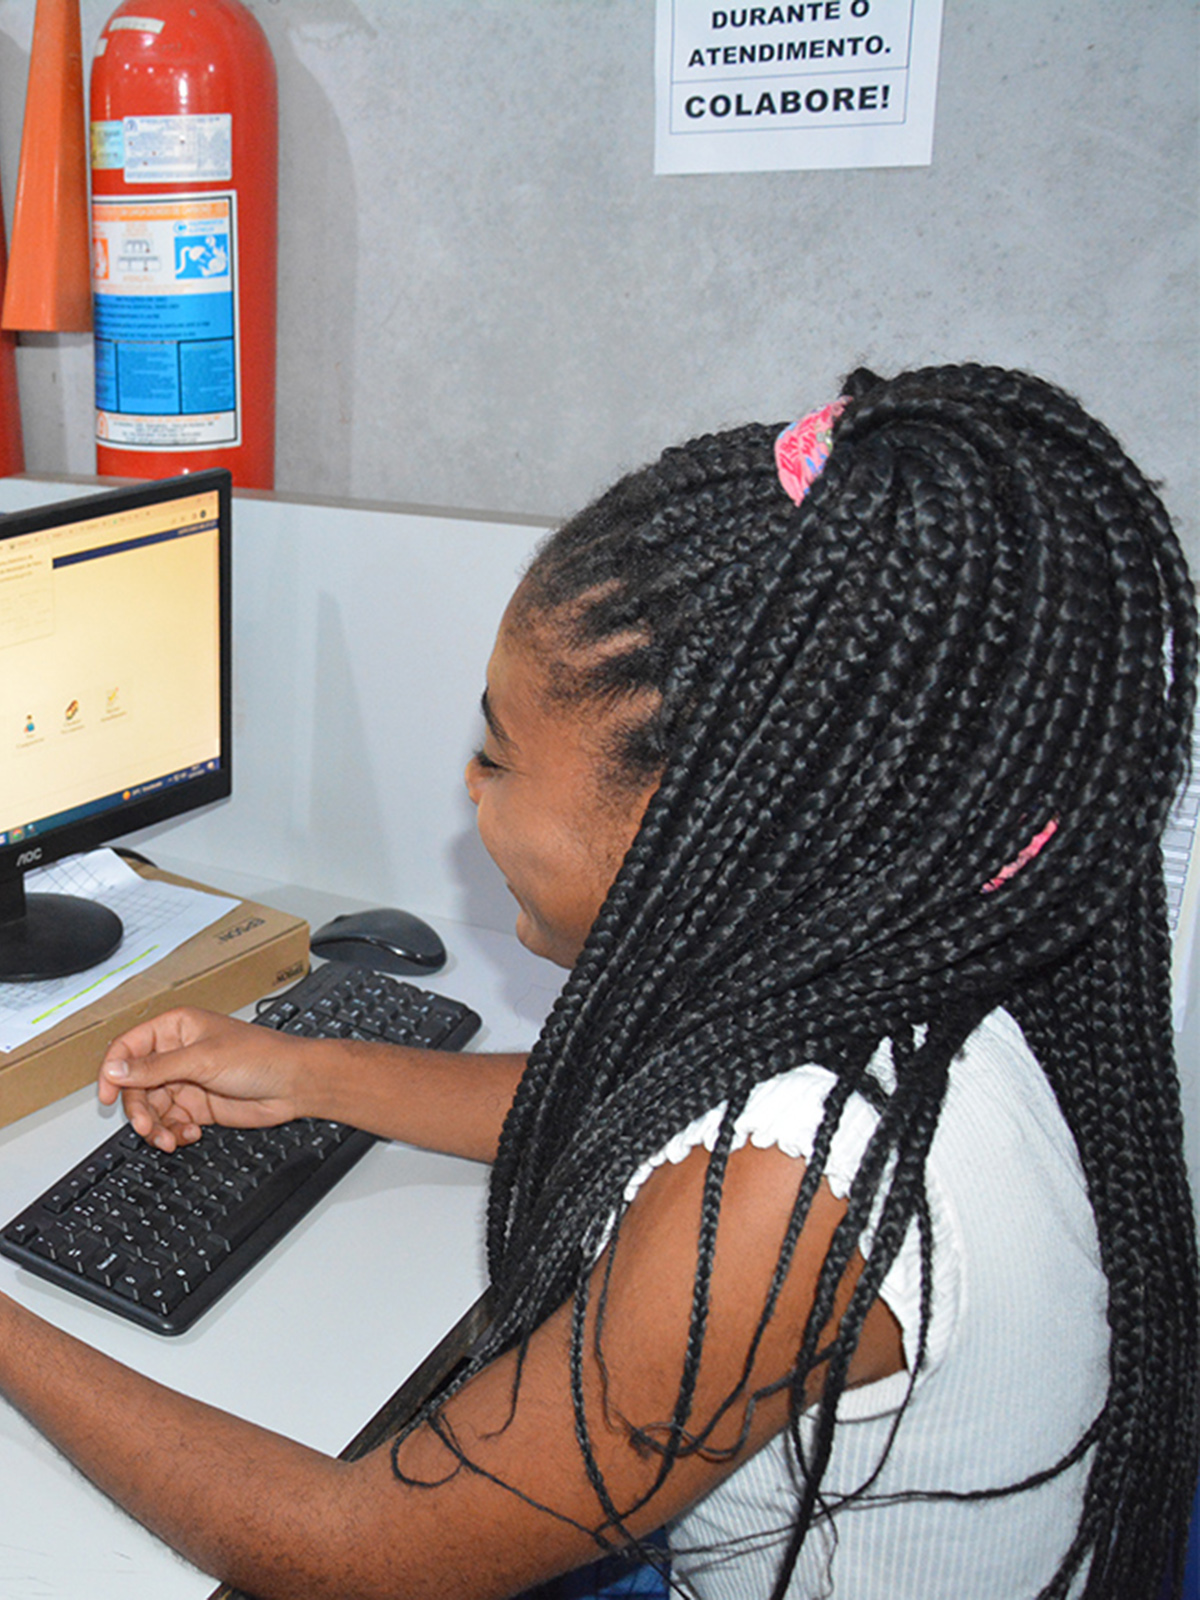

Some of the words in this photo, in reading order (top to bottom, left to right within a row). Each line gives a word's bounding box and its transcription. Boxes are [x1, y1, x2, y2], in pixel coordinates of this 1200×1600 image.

[711, 0, 841, 30] DURANTE
[850, 0, 870, 18] O
[688, 35, 891, 68] ATENDIMENTO.
[684, 84, 891, 119] COLABORE!
[16, 847, 43, 867] AOC
